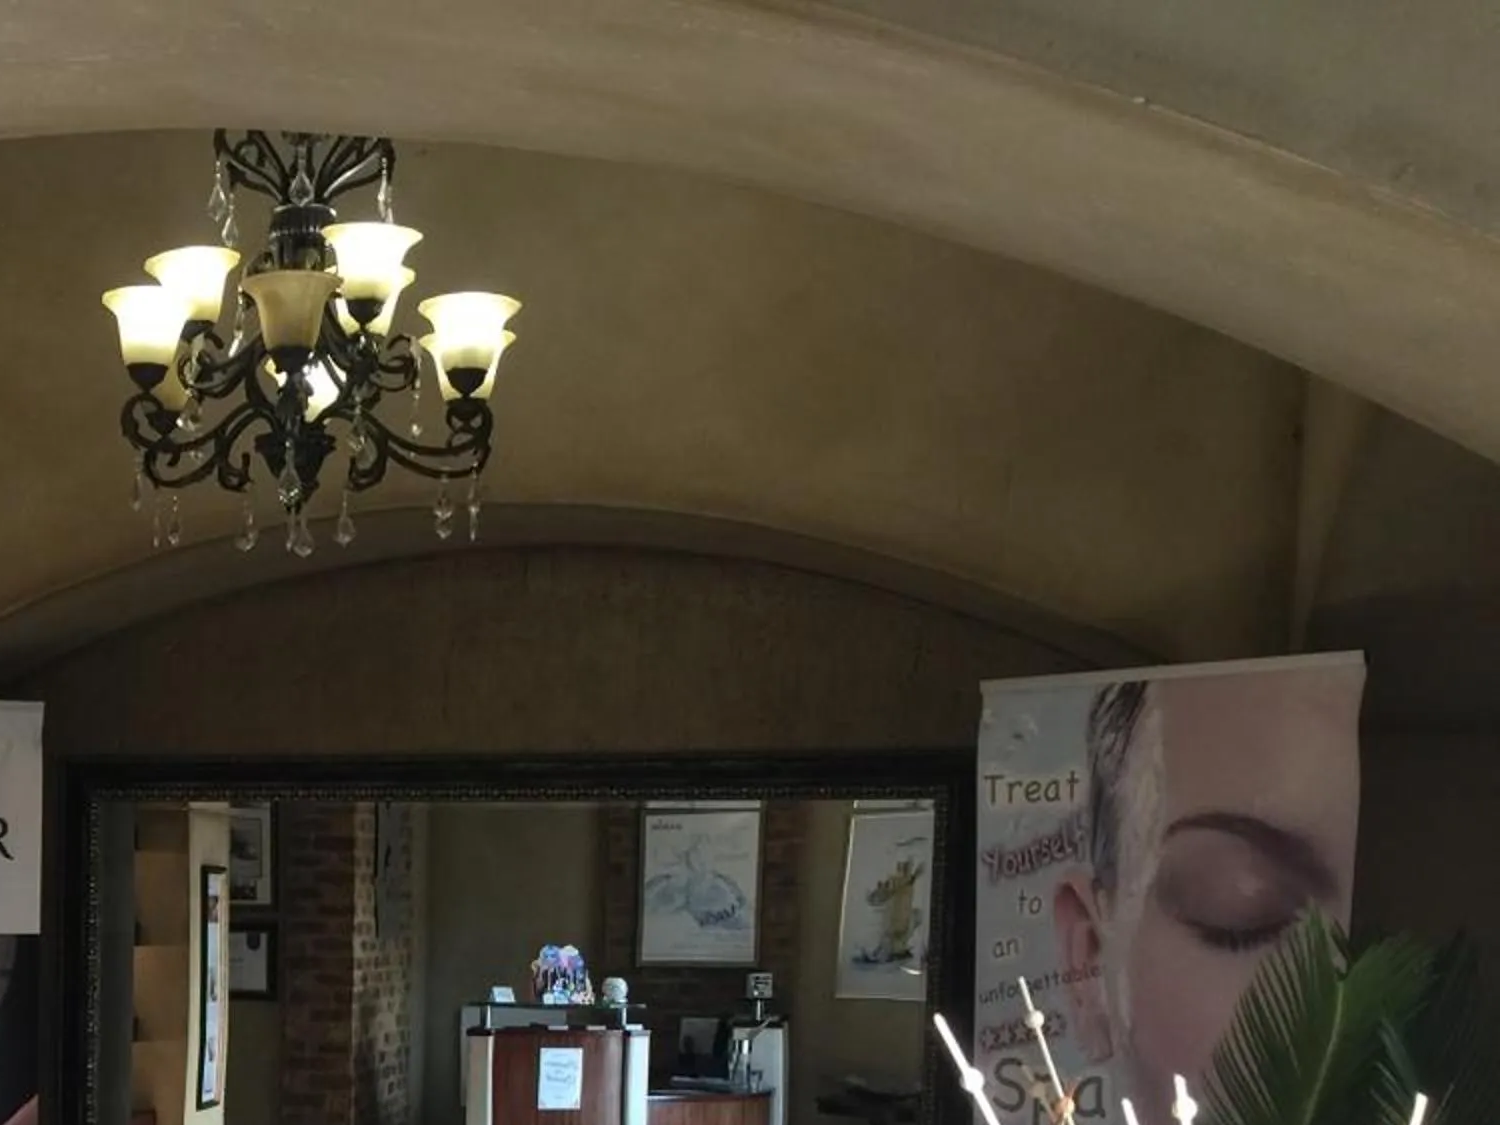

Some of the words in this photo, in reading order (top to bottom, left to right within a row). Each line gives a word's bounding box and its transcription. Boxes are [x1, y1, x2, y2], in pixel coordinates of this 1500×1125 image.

[984, 769, 1081, 806] Treat
[982, 819, 1088, 881] Yourself
[1017, 890, 1043, 916] to
[992, 936, 1019, 960] an
[979, 963, 1101, 1004] unfogettable
